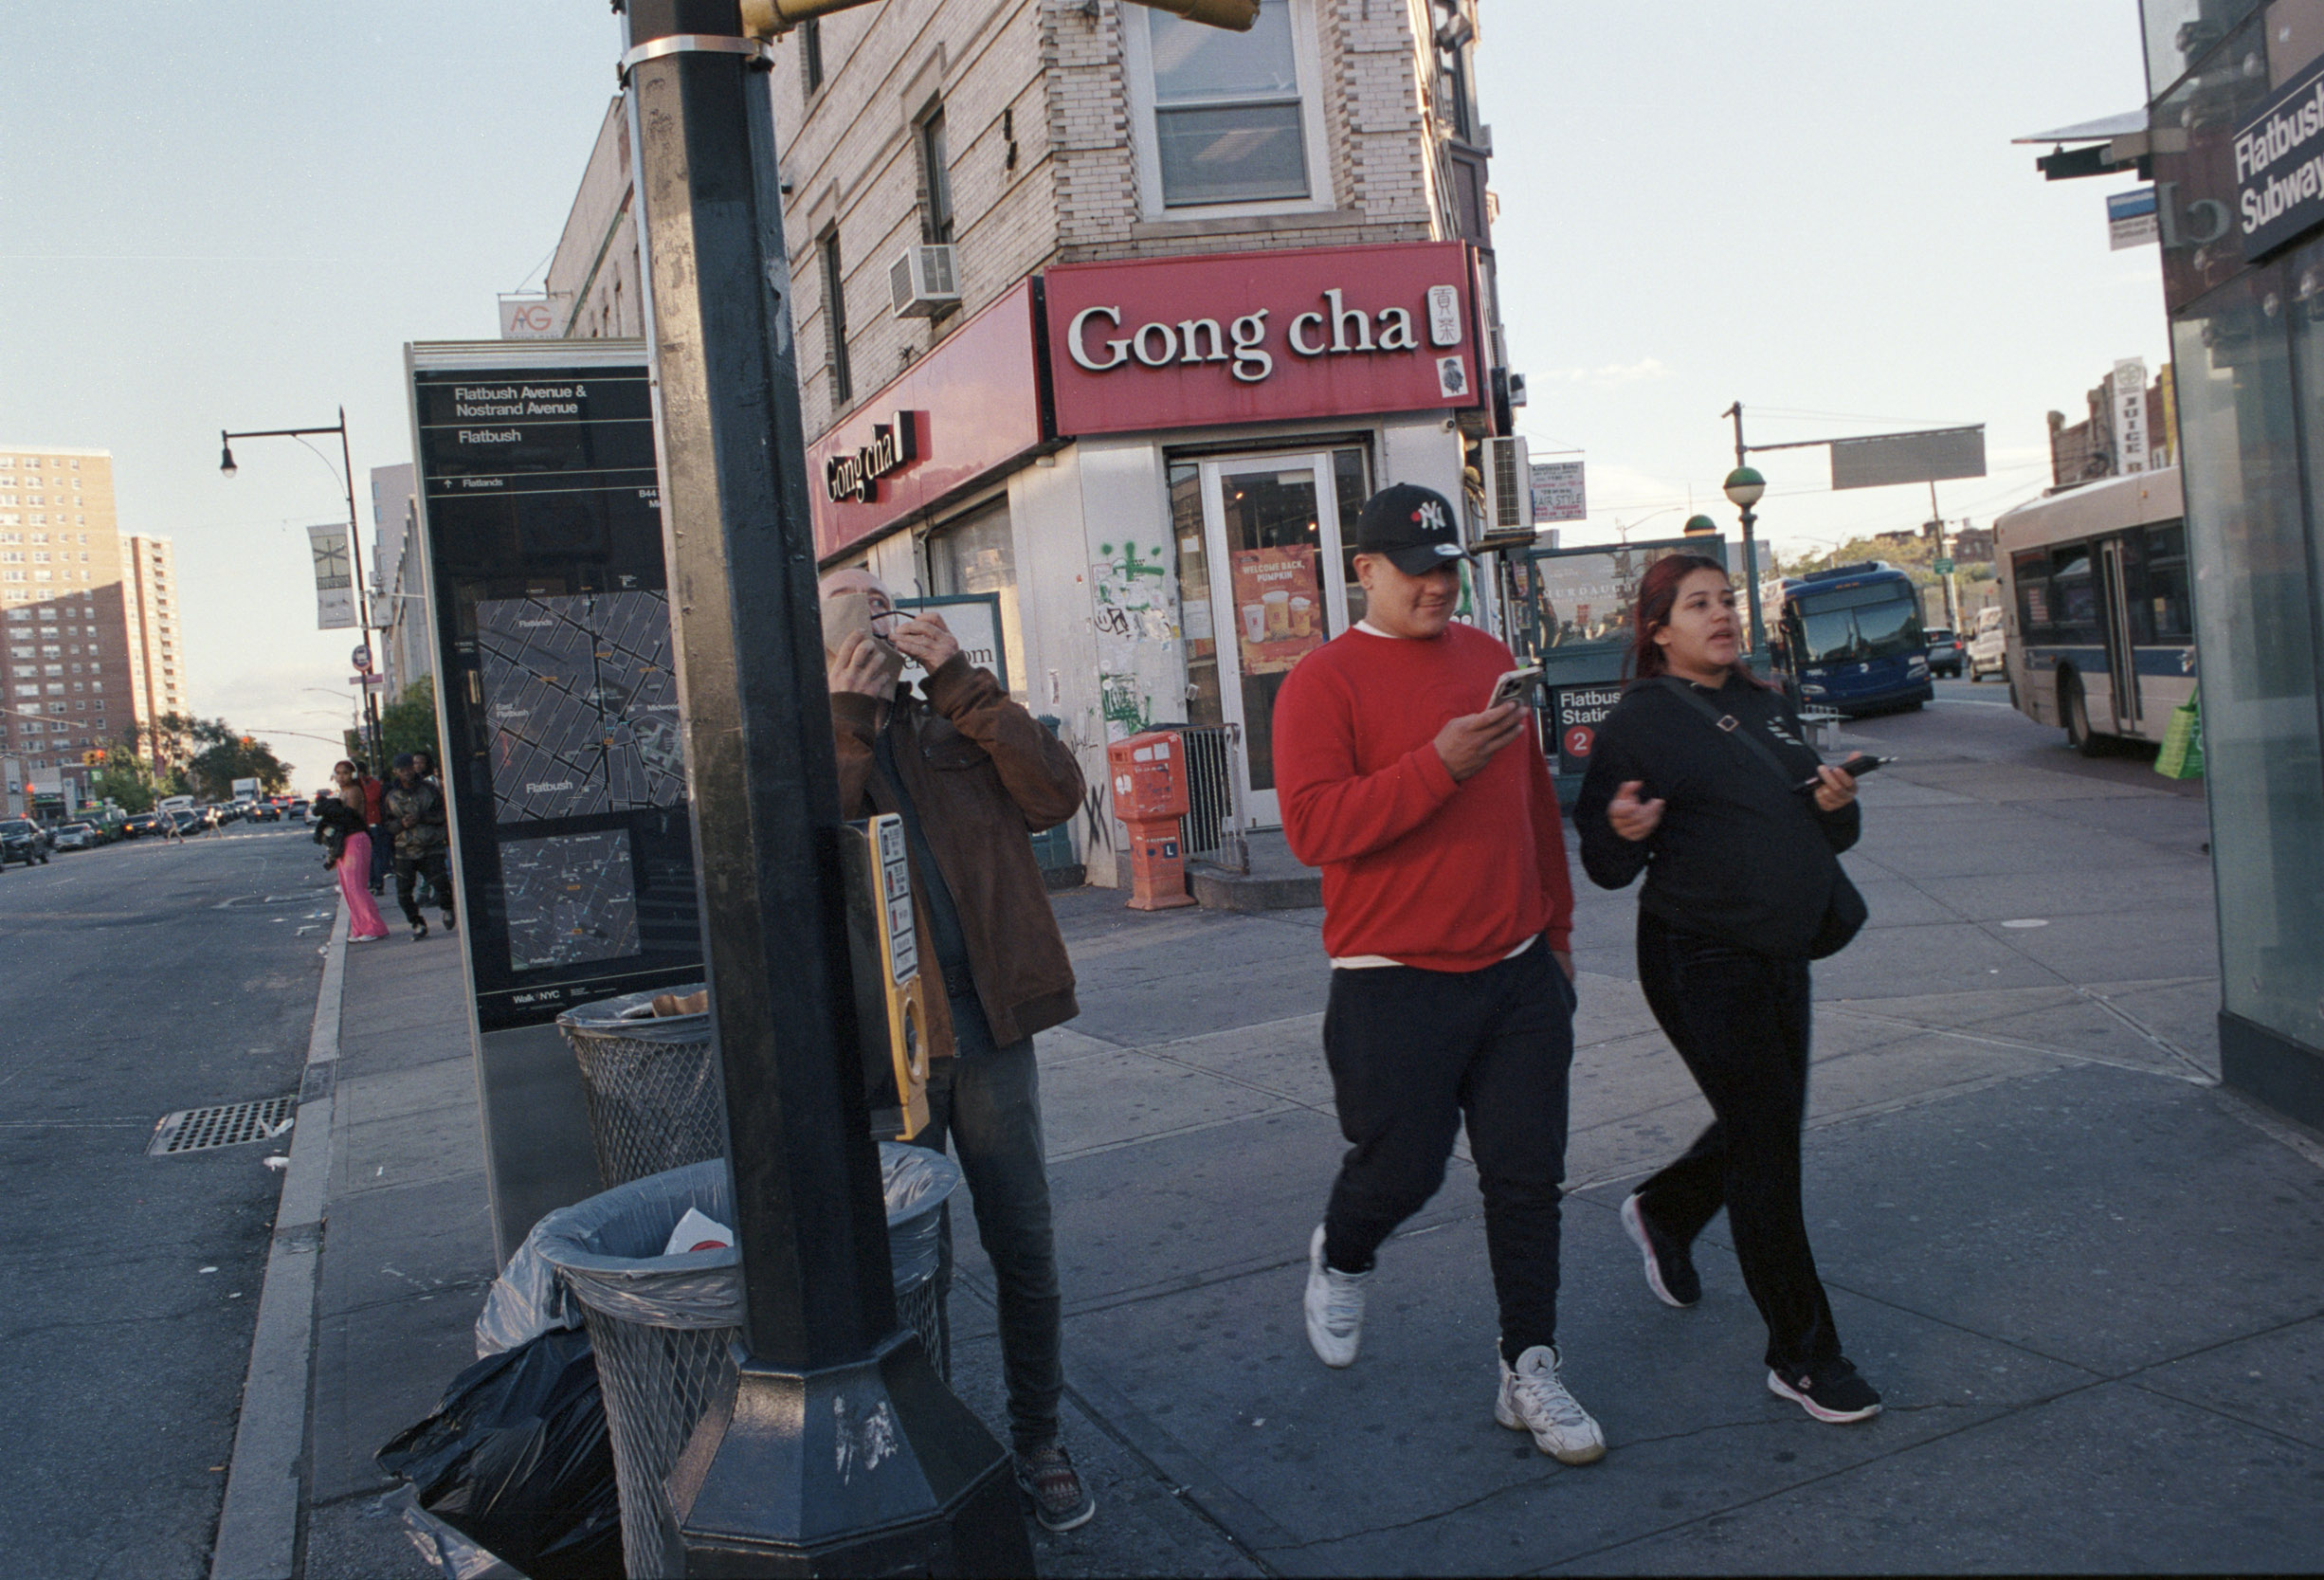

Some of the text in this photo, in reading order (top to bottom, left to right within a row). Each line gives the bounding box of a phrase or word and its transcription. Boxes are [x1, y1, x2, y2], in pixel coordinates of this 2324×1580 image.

[509, 304, 553, 333] AG
[1432, 287, 1457, 341] 貢茶
[1067, 288, 1419, 383] Gong cha
[454, 385, 588, 401] Flatbush Avenue &
[456, 402, 578, 417] Nostrand Avenue
[458, 428, 522, 444] Flatbush
[463, 478, 504, 488] Flatlands
[826, 448, 865, 503] Gong
[639, 489, 657, 499] B44
[1418, 500, 1447, 531] NY
[1243, 561, 1305, 573] WELCOME BACK,
[1257, 572, 1293, 582] PUMPKIN
[496, 702, 515, 711] East
[1560, 690, 1623, 708] Flatbus
[646, 703, 679, 712] Midwoo
[1562, 707, 1610, 725] Stati
[1573, 732, 1588, 751] 2
[525, 779, 573, 794] Flatbush
[1166, 844, 1174, 856] L
[513, 993, 536, 1005] Walk
[539, 989, 560, 1001] NYC
